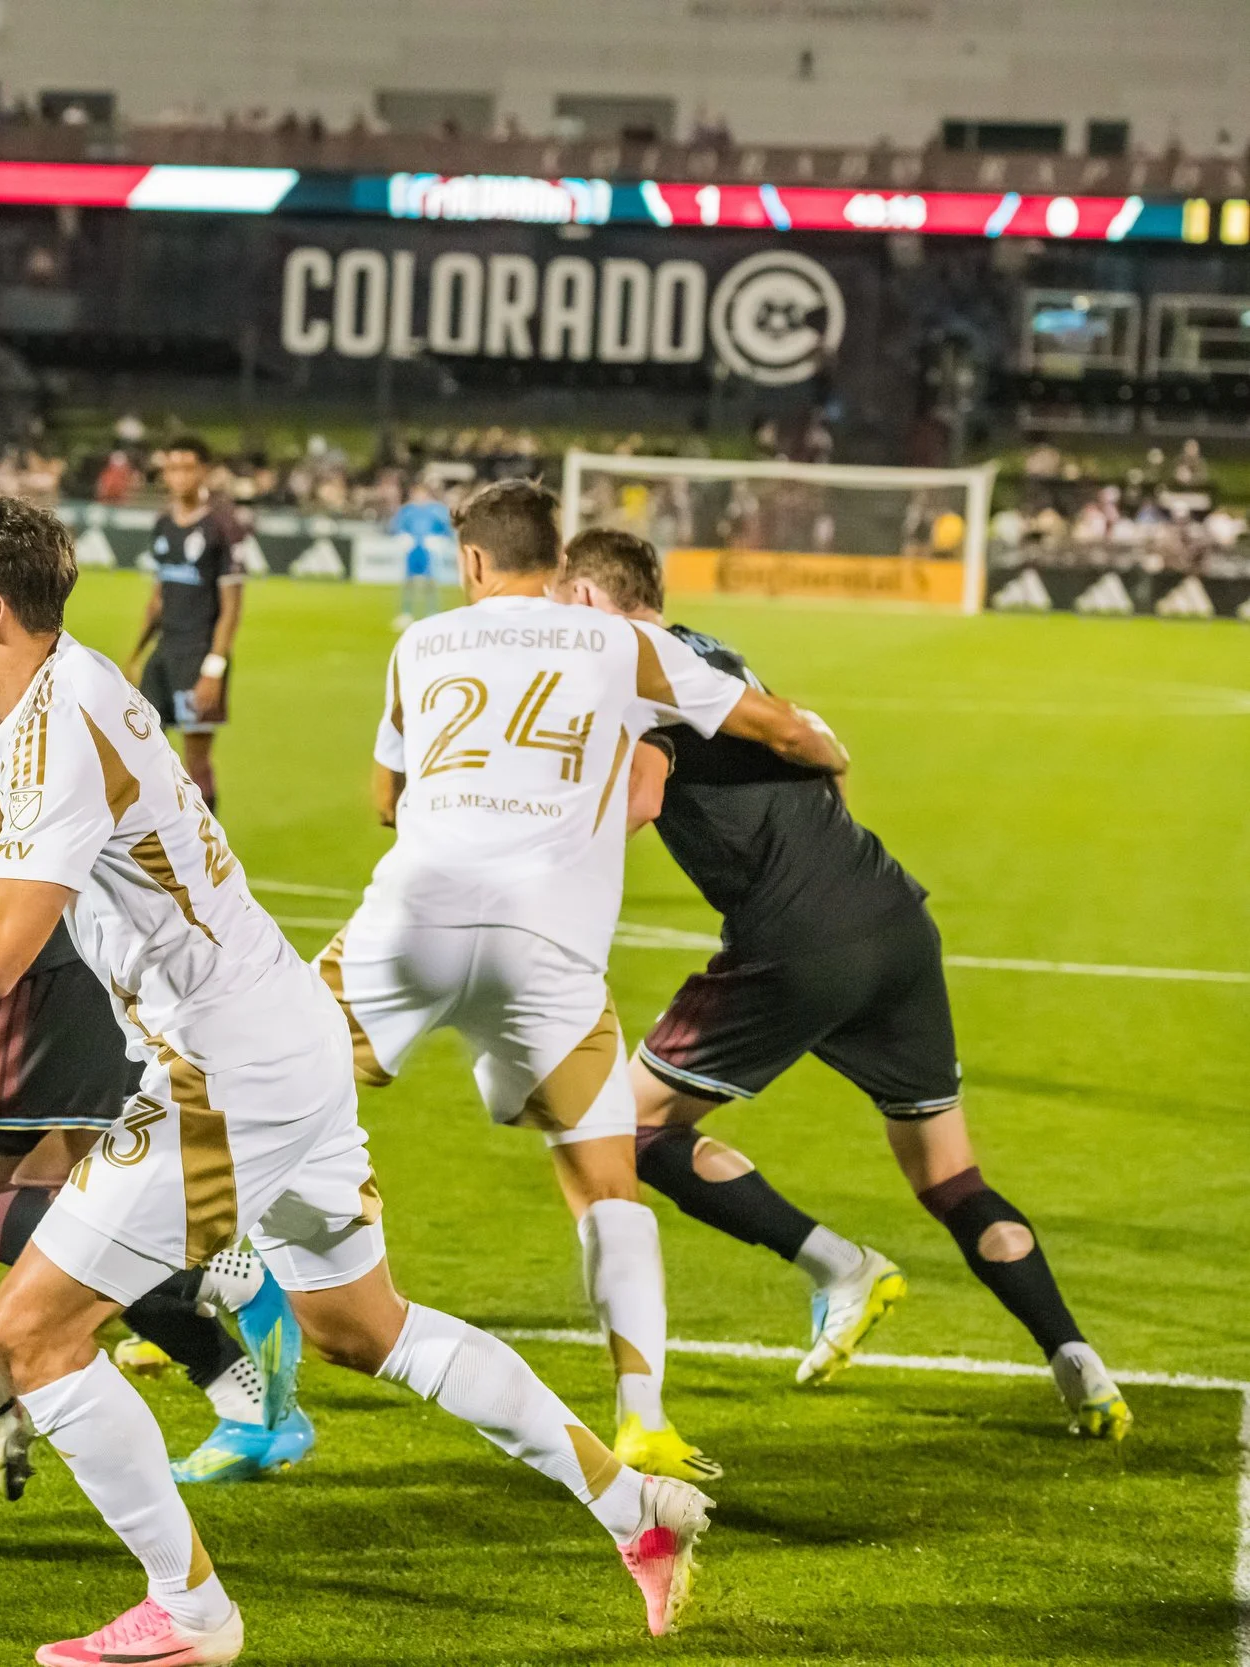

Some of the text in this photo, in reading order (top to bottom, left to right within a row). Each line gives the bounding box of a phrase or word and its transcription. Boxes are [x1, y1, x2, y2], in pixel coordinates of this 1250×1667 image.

[281, 247, 707, 363] COLORADO
[415, 629, 606, 661] HOLLINGSHEAD
[420, 671, 595, 783] 24
[12, 795, 28, 803] MLS
[430, 794, 562, 818] EL MEXICANO
